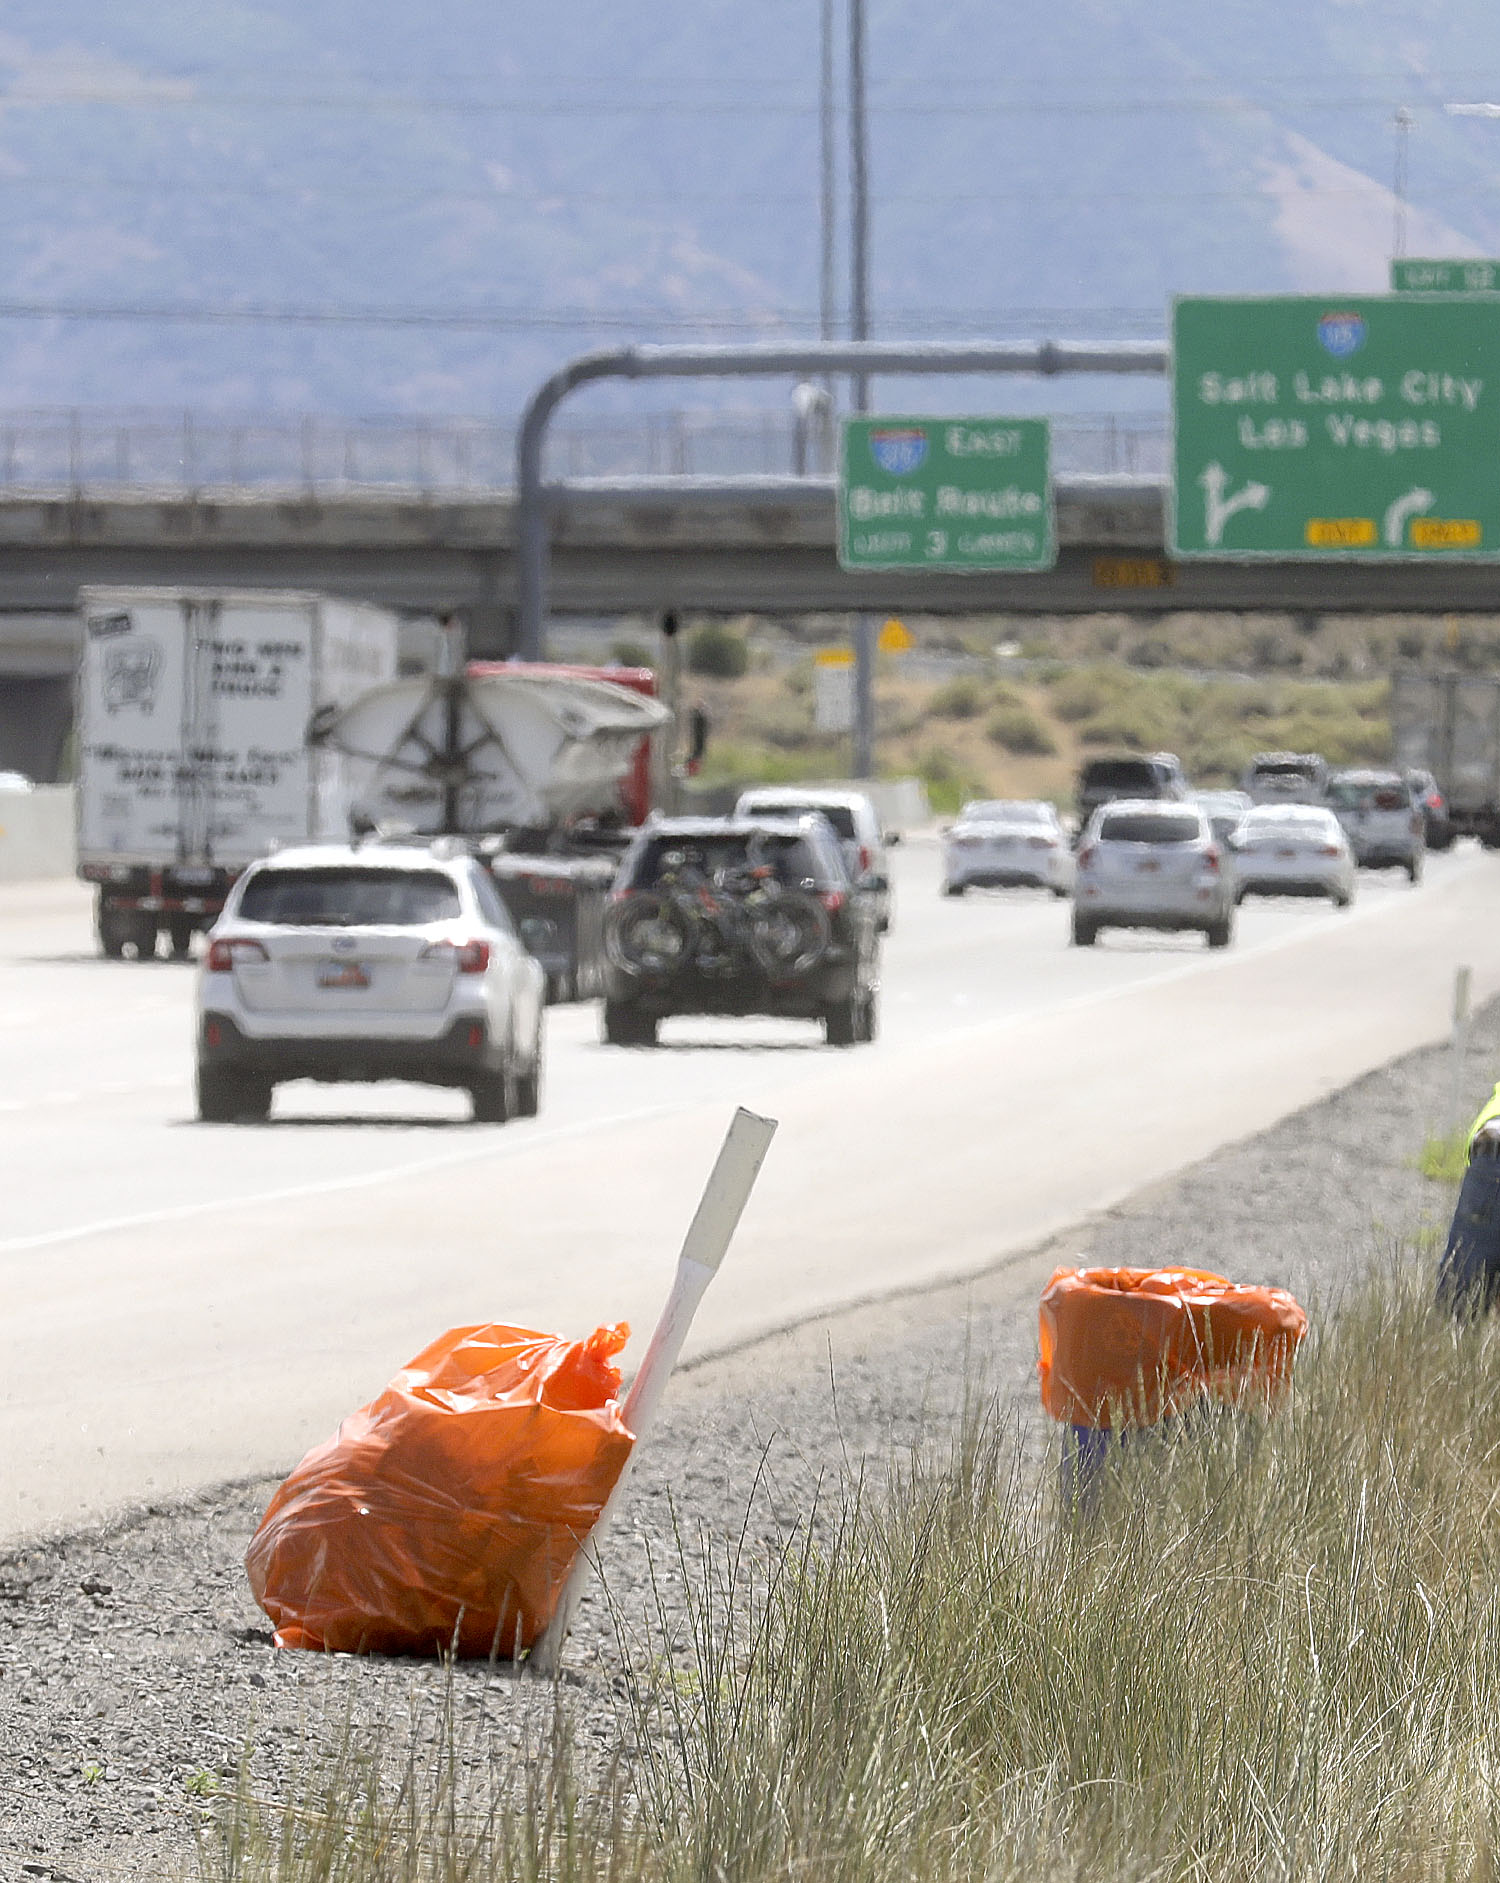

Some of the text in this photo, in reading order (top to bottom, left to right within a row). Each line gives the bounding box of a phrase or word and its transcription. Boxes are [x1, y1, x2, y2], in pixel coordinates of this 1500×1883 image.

[1200, 369, 1482, 411] Salt Lake City
[1238, 413, 1441, 454] Las Vegas
[925, 530, 946, 557] 3
